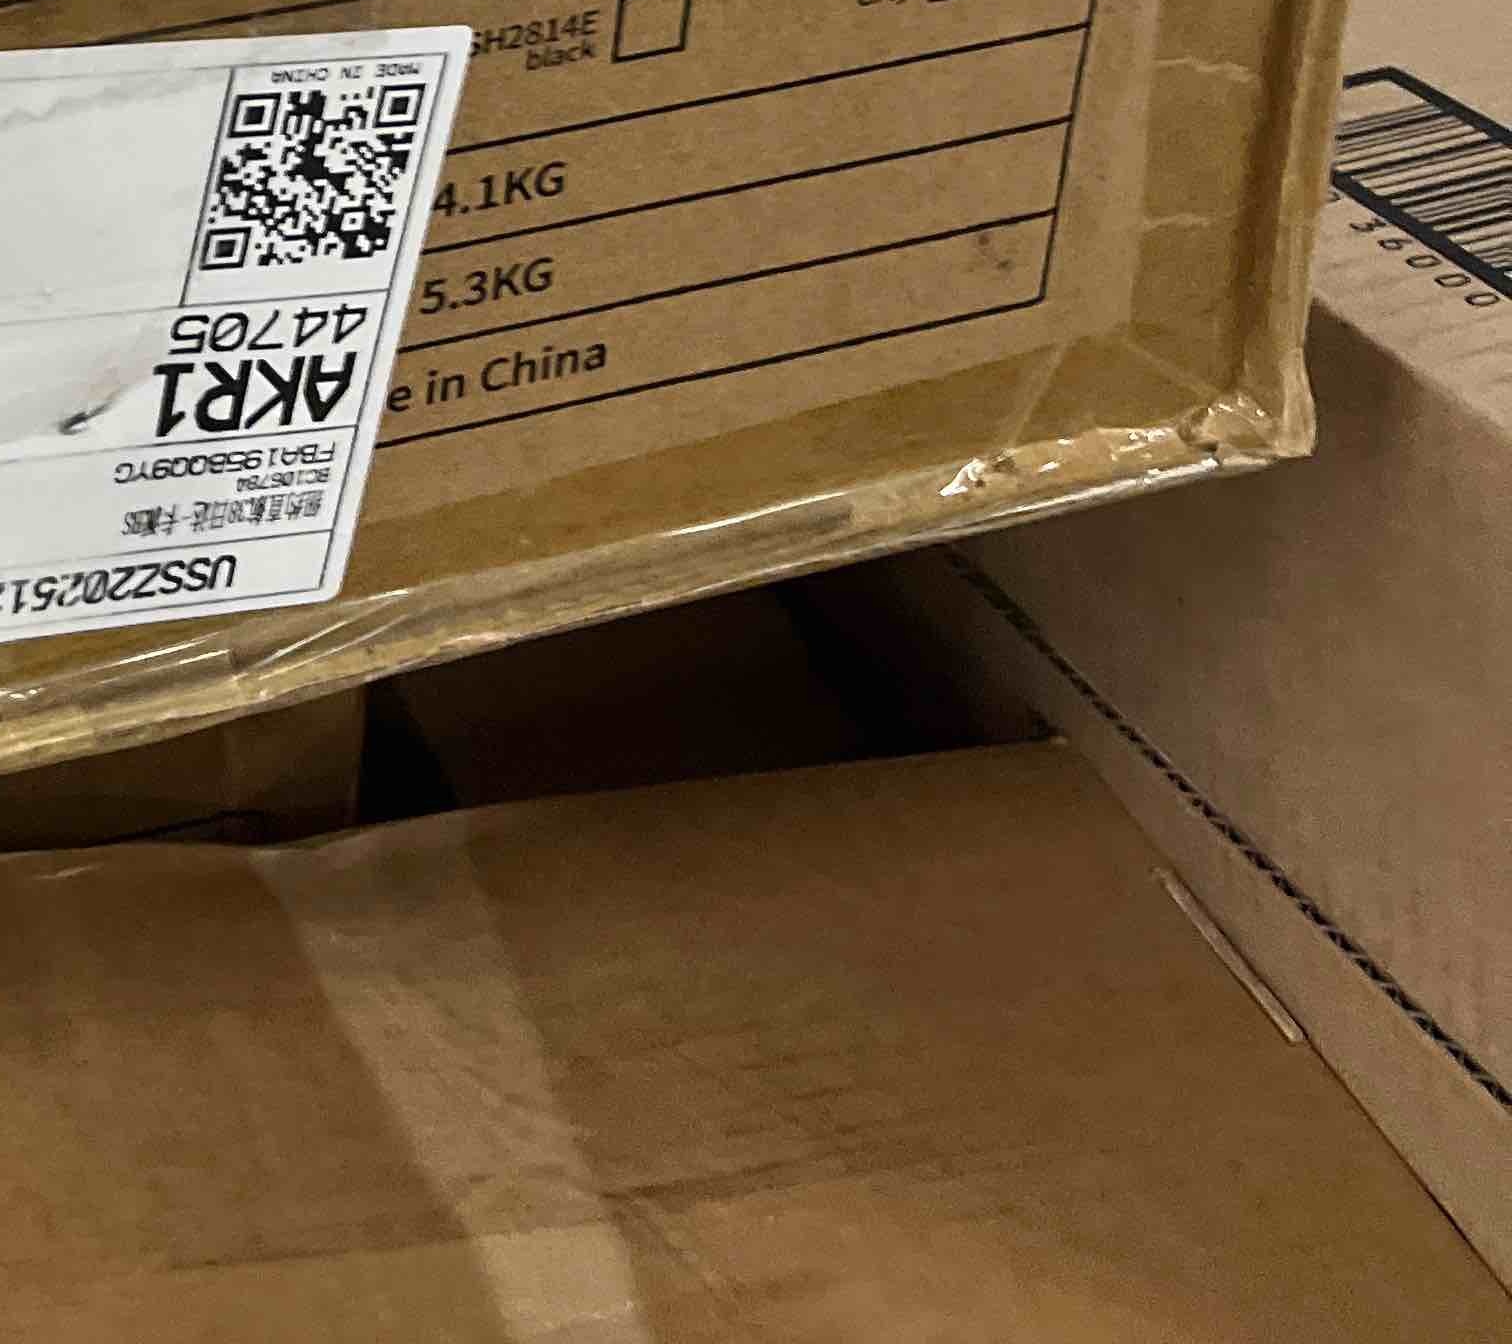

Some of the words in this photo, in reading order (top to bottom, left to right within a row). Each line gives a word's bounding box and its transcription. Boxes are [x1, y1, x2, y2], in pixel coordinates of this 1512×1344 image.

[472, 10, 600, 57] SH2814E
[526, 40, 597, 71] black
[432, 162, 568, 217] 4.1KG
[419, 257, 554, 314] 5.3KG
[164, 299, 370, 358] 44705
[138, 344, 360, 440] AKR1
[426, 370, 465, 404] in
[480, 343, 607, 392] China
